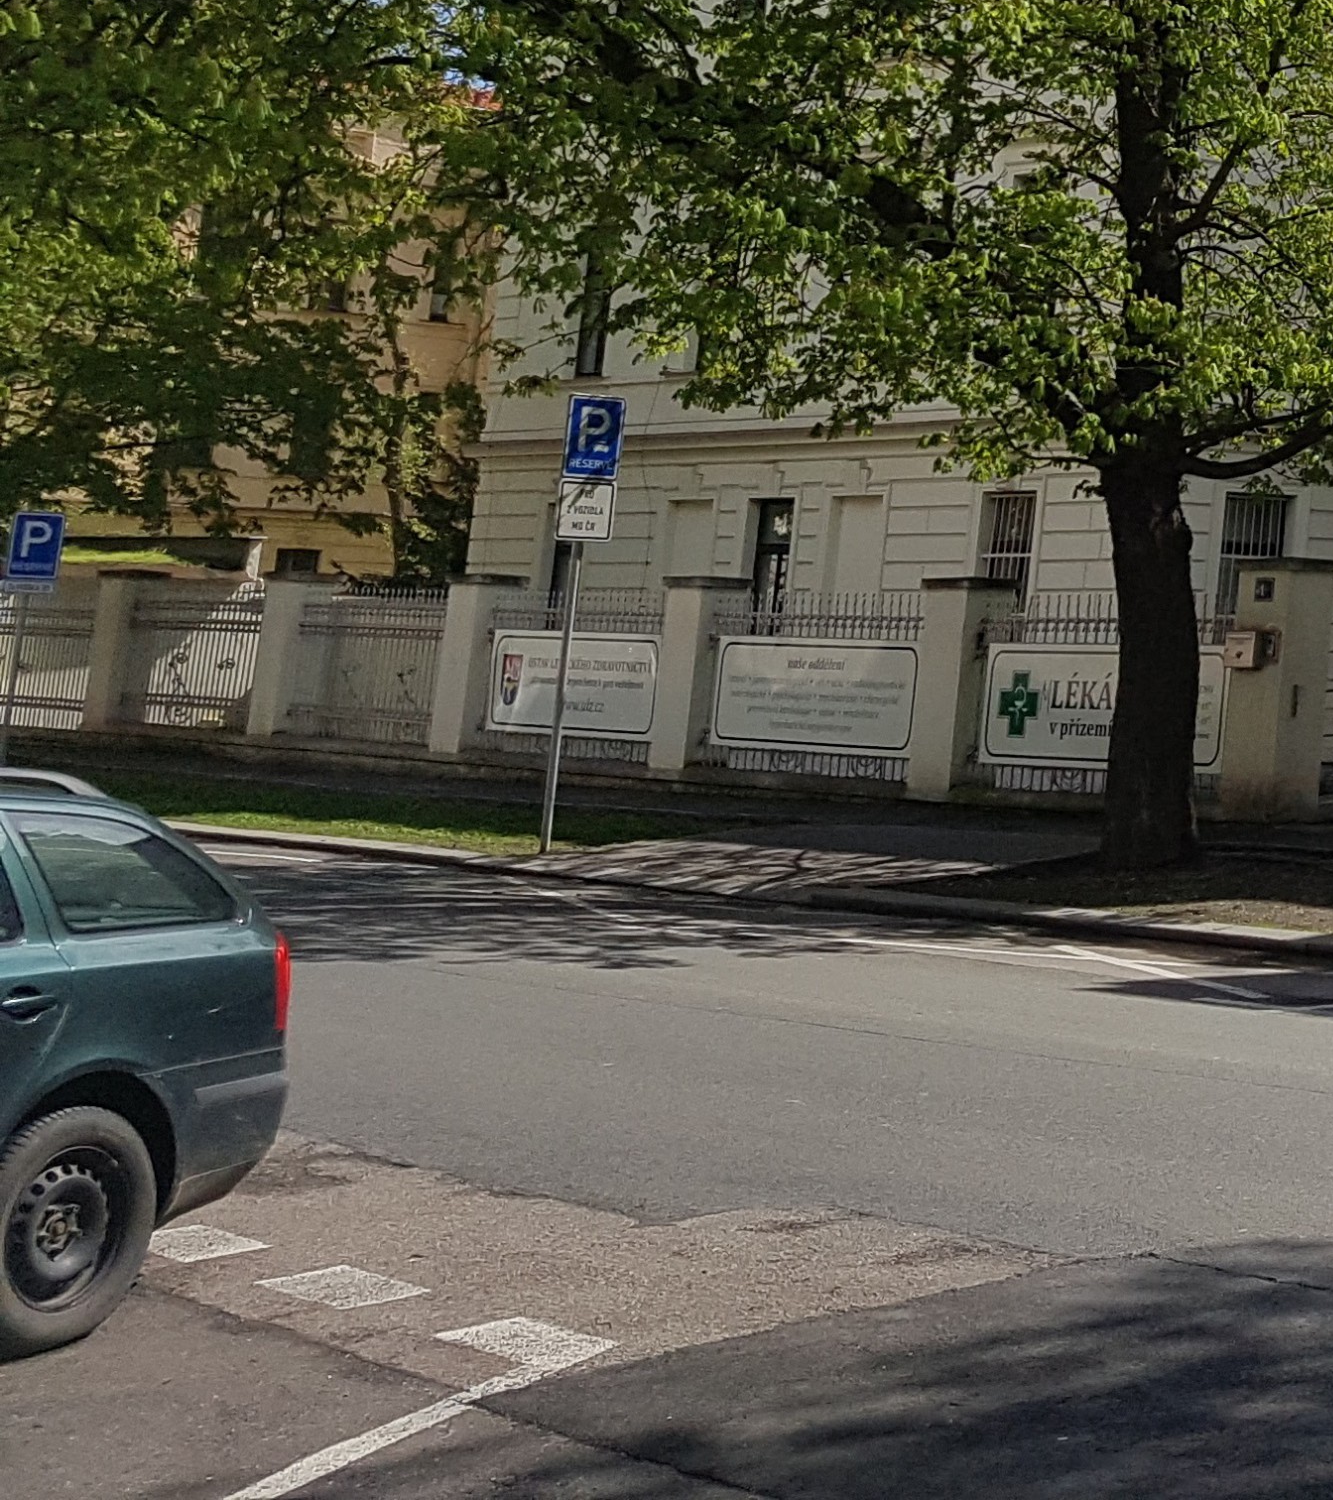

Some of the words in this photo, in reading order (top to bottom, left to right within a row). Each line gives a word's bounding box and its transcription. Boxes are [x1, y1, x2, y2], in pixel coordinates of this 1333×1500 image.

[578, 405, 612, 453] P
[20, 520, 54, 558] P
[1050, 722, 1059, 736] v
